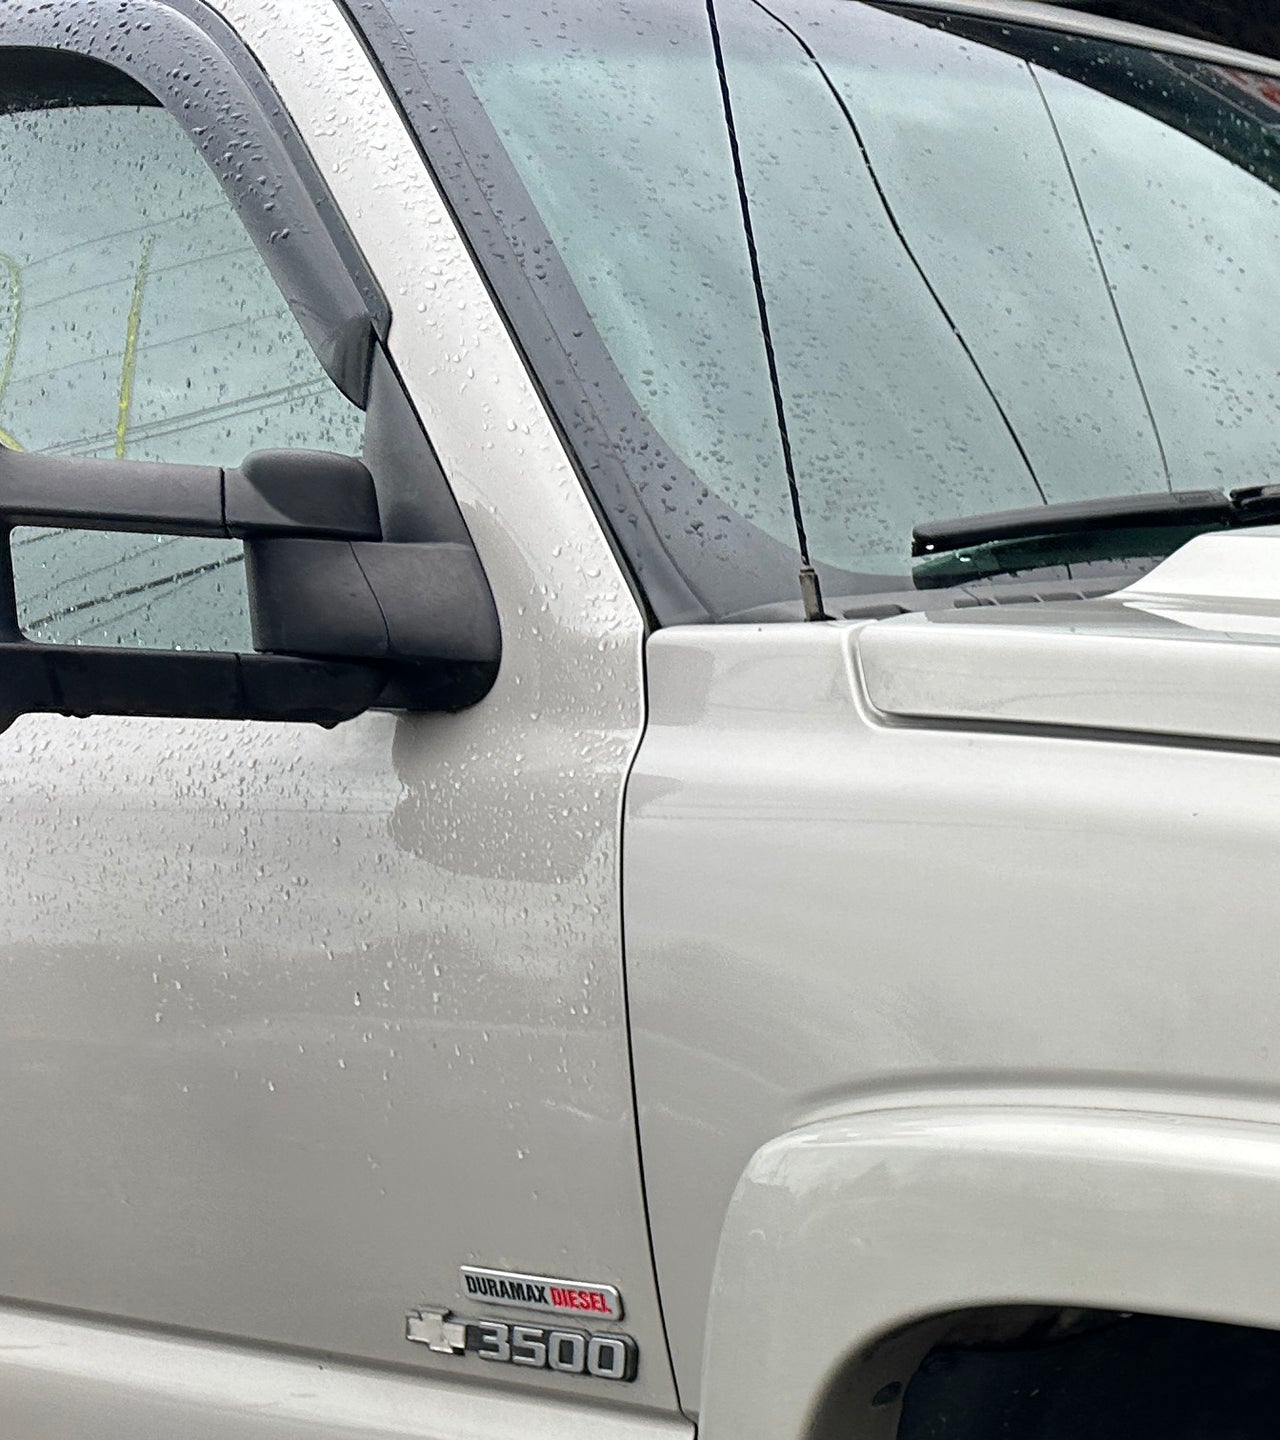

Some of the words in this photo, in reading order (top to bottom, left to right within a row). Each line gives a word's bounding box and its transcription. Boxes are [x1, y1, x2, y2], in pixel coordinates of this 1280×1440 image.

[464, 1275, 549, 1305] DURAMAX
[550, 1287, 613, 1315] DIESEL
[477, 1320, 631, 1380] 3500
